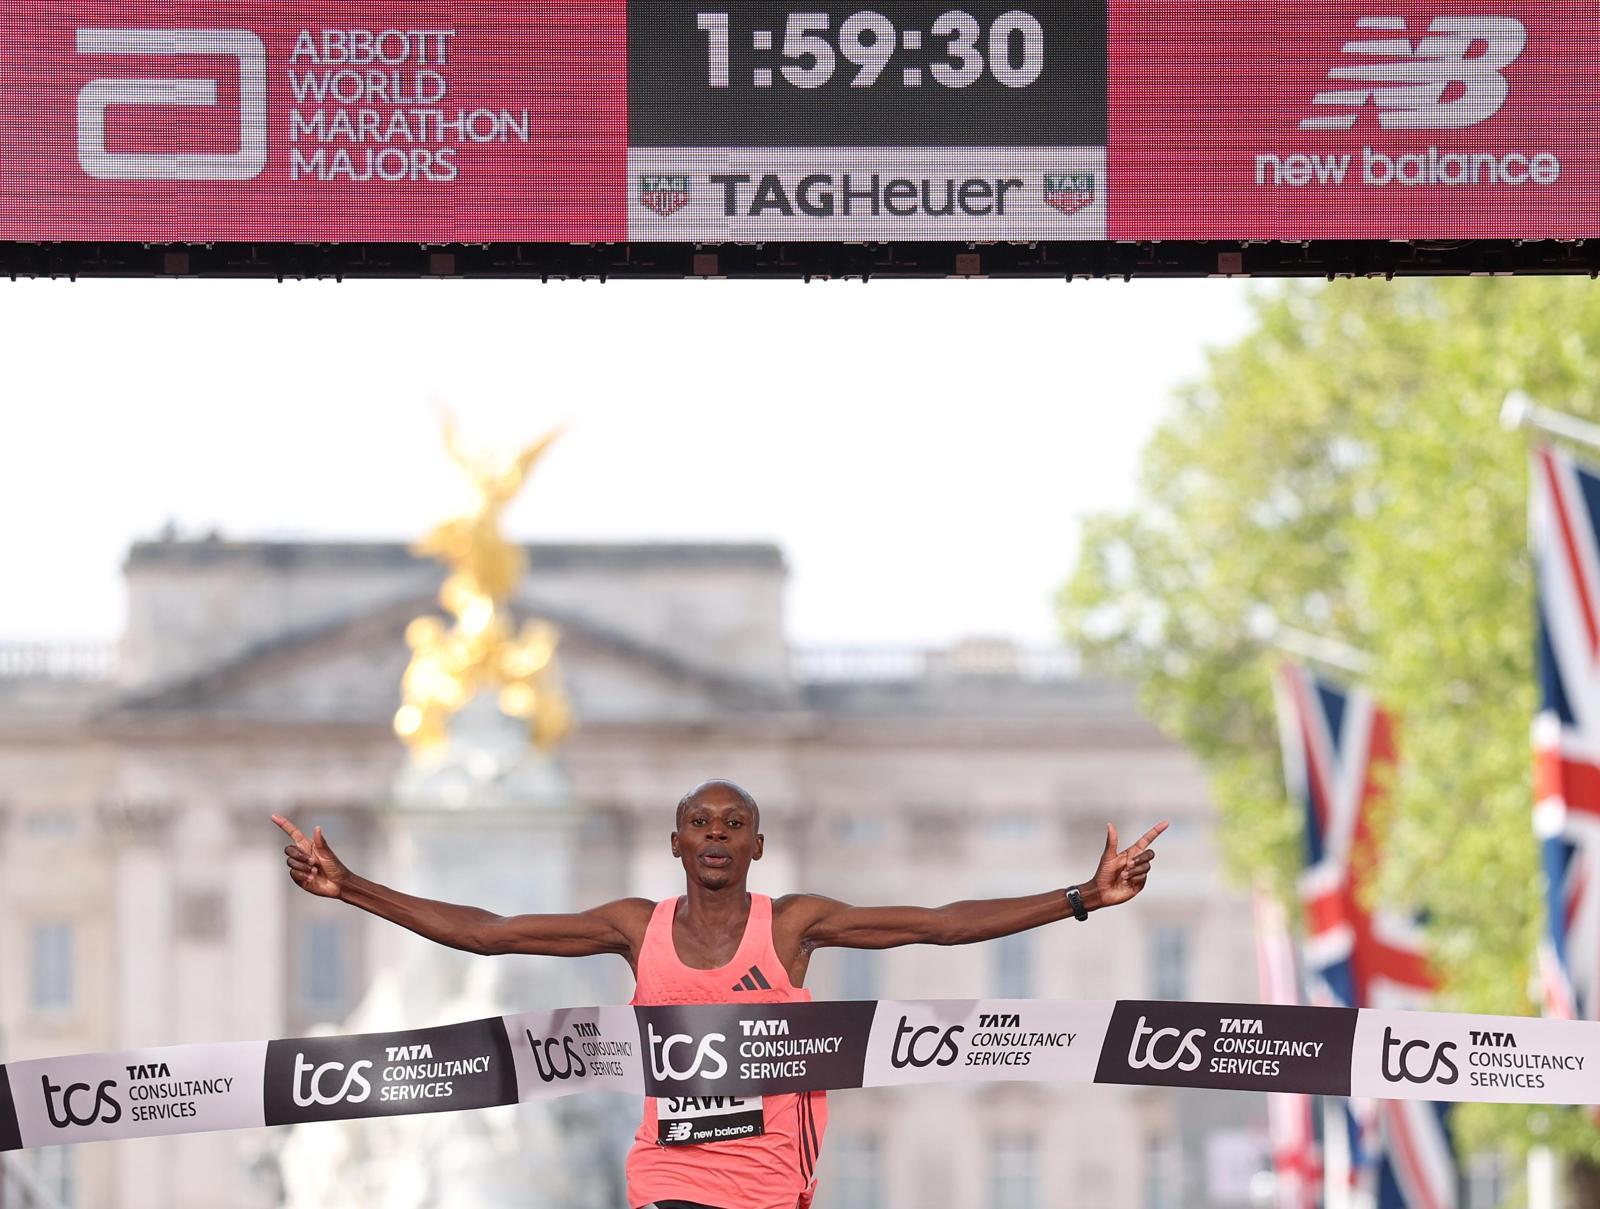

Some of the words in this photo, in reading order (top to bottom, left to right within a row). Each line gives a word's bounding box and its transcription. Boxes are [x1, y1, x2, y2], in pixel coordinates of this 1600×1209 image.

[289, 29, 456, 65] ABBOTT
[697, 10, 1044, 88] 1:59:30
[288, 70, 447, 103] WORLD
[289, 109, 531, 142] MARATHON
[289, 149, 459, 182] MAJORS
[1255, 152, 1351, 185] new
[1362, 146, 1562, 185] balance
[572, 1022, 601, 1037] TATA
[739, 1019, 789, 1036] TATA
[979, 1014, 1020, 1028] TATA
[1220, 1018, 1263, 1034] TATA
[739, 1036, 843, 1058] CONSULTANCY
[890, 1015, 965, 1068] tcs
[971, 1032, 1076, 1047] CONSULTANCY
[1127, 1016, 1206, 1072] tcs
[1213, 1038, 1323, 1057] CONSULTANCY
[1469, 1031, 1517, 1047] TATA
[386, 1044, 433, 1061] TATA
[526, 1029, 586, 1082] tcs
[582, 1042, 633, 1056] CONSULTANCY
[648, 1022, 728, 1081] tcs
[965, 1051, 1031, 1066] SERVICES
[1381, 1026, 1459, 1085] tcs
[126, 1063, 171, 1078] TATA
[382, 1056, 490, 1080] CONSULTANCY
[590, 1061, 624, 1076] SERVICES
[740, 1060, 807, 1080] SERVICES
[1209, 1058, 1280, 1076] SERVICES
[1469, 1052, 1585, 1070] CONSULTANCY
[129, 1077, 233, 1101] CONSULTANCY
[293, 1053, 371, 1106] tcs
[1470, 1072, 1545, 1088] SERVICES
[380, 1082, 453, 1101] SERVICES
[42, 1075, 121, 1128] tcs
[132, 1102, 197, 1121] SERVICES
[693, 1130, 713, 1139] new
[714, 1125, 754, 1137] balance
